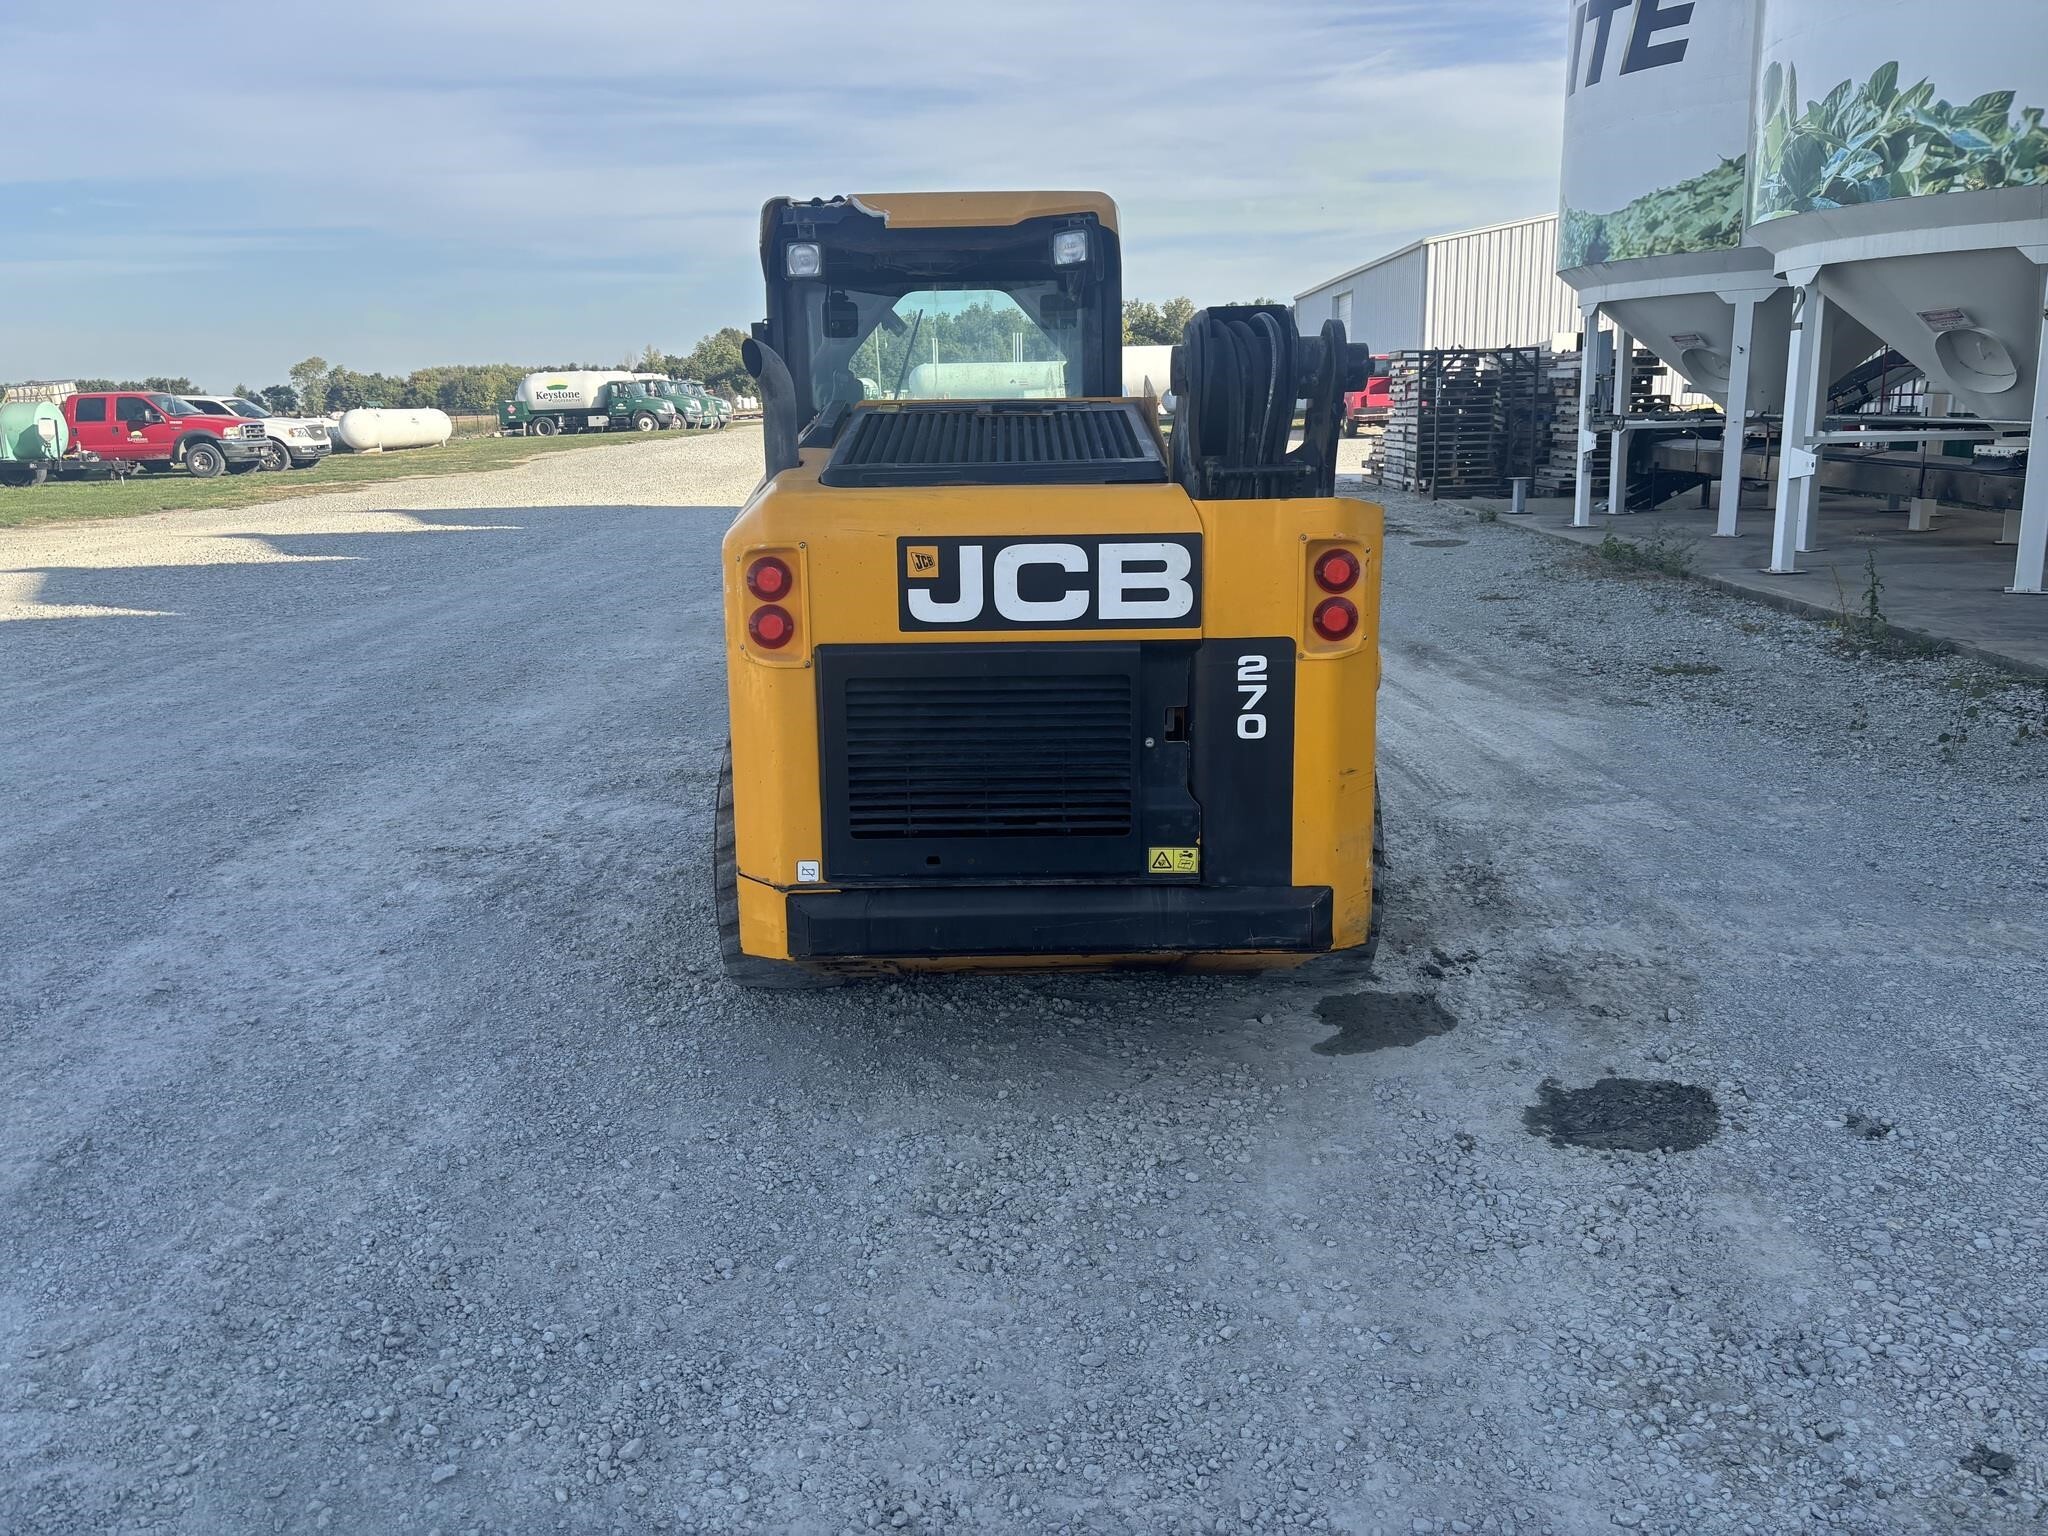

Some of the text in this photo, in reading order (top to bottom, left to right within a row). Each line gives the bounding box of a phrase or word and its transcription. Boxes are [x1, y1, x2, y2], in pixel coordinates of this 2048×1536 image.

[1568, 0, 1695, 97] ITE
[1791, 286, 1806, 330] 2
[536, 391, 580, 401] Keystone
[908, 542, 1194, 623] JCB
[915, 554, 934, 569] JCB
[1237, 655, 1268, 739] 270
